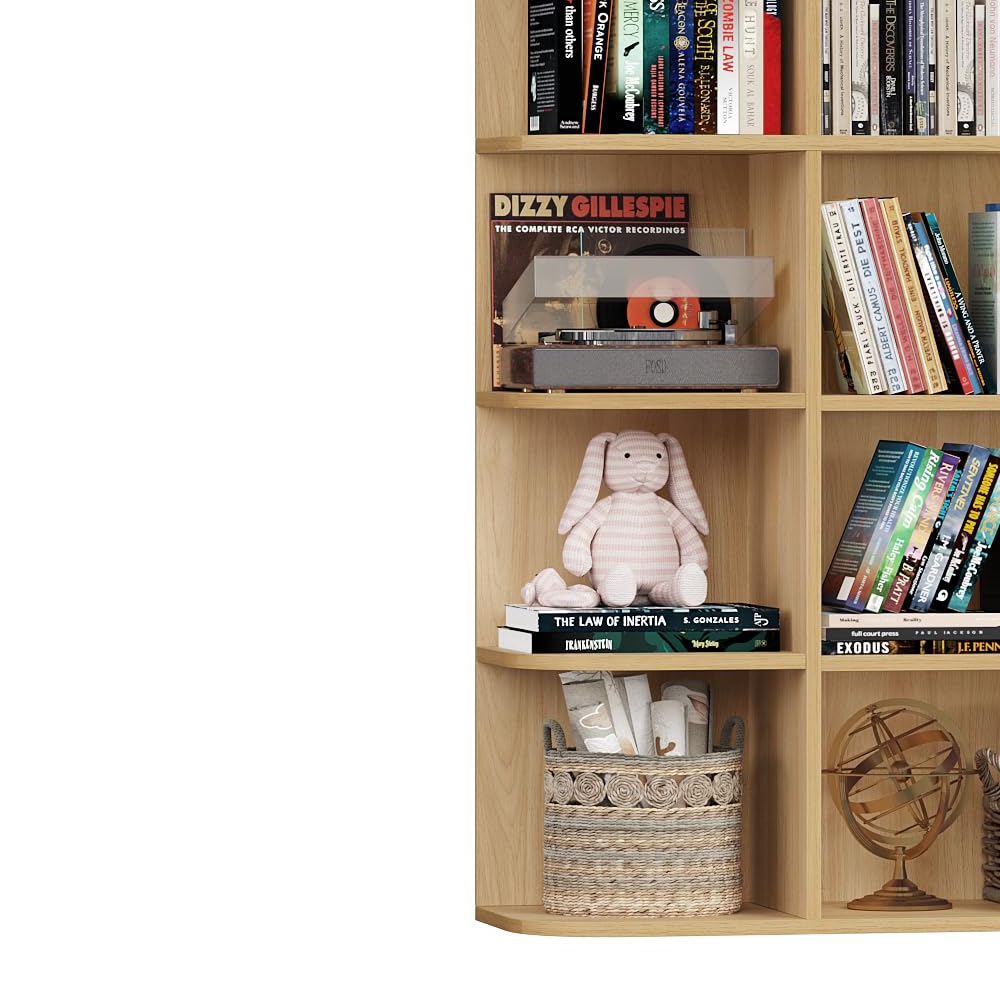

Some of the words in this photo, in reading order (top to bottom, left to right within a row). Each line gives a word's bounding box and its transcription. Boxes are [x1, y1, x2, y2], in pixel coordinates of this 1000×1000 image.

[565, 6, 576, 24] than
[623, 0, 639, 38] MERCY
[565, 26, 574, 59] others
[593, 13, 608, 61] ORANGE
[722, 47, 734, 73] LAW
[494, 195, 569, 217] DIZZY
[572, 196, 686, 218] GILLESPIE
[626, 226, 686, 234] RECORDINGS
[555, 617, 575, 626] THE
[579, 616, 603, 626] LAW
[607, 616, 621, 626] OF
[623, 616, 666, 627] INERTIA
[837, 642, 890, 653] EXODUS
